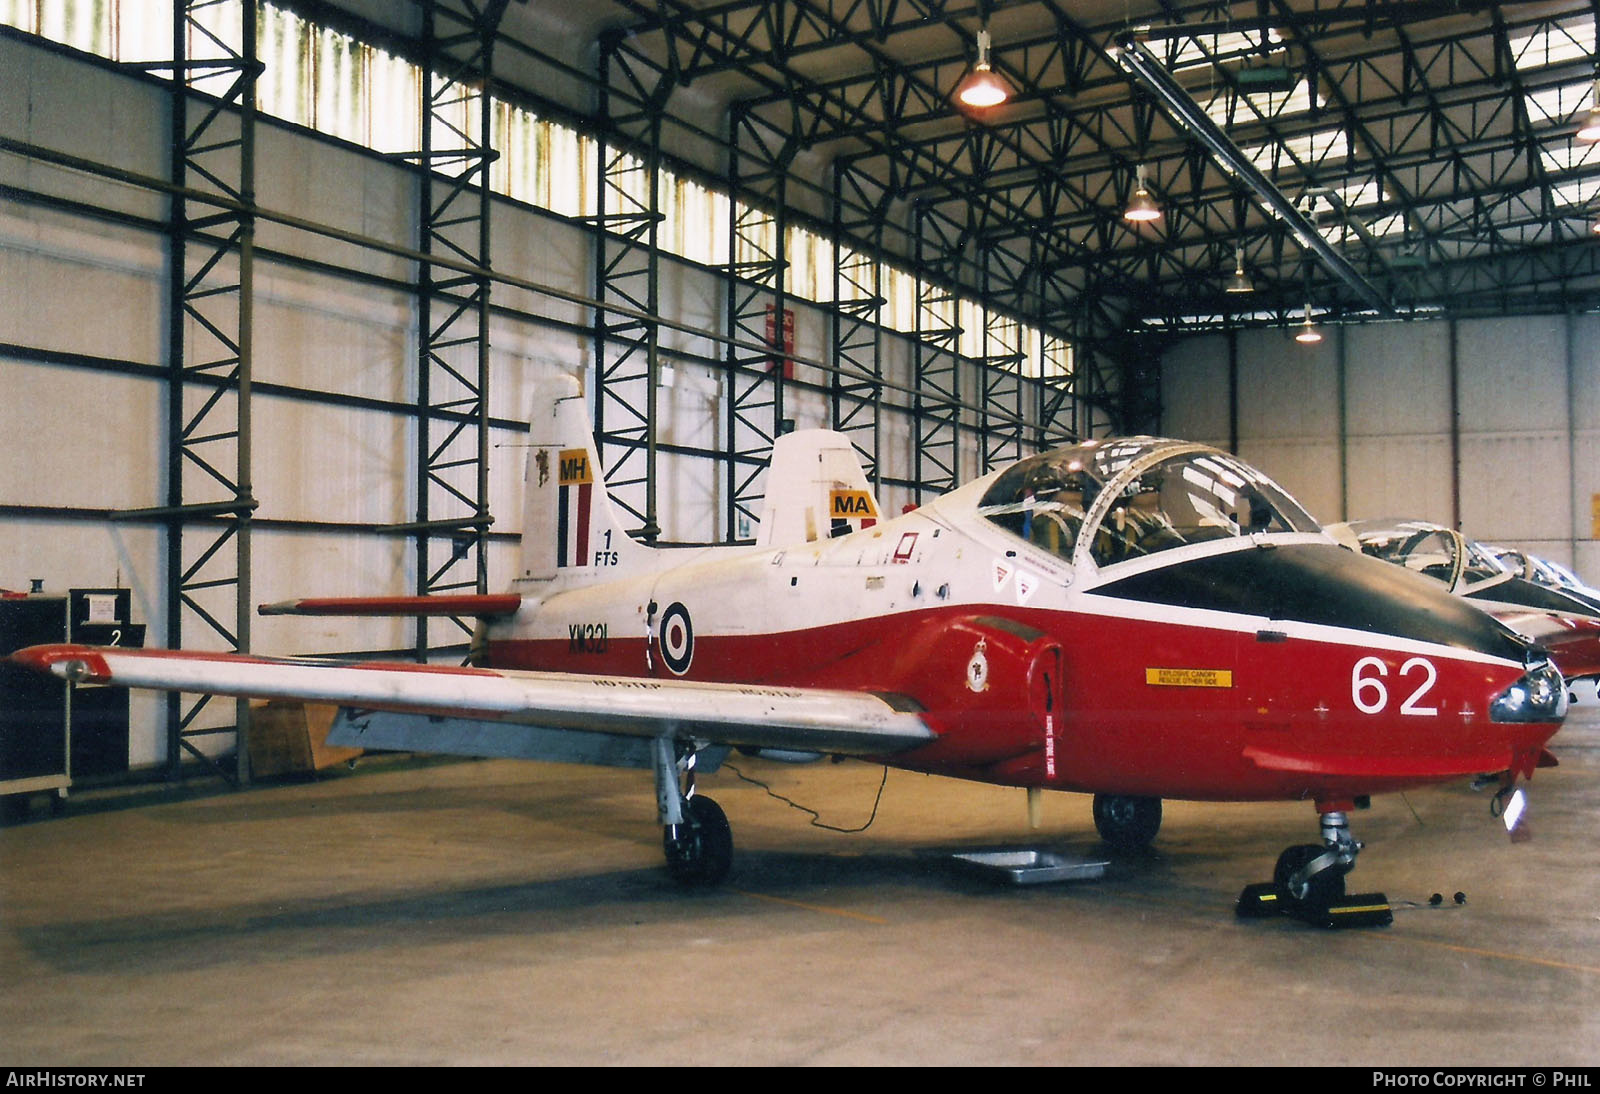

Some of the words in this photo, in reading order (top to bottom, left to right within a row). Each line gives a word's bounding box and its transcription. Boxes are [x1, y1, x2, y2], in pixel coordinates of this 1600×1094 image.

[560, 457, 586, 480] MH
[834, 495, 870, 513] MA
[604, 529, 611, 550] 1
[594, 551, 618, 566] FTS
[111, 629, 121, 647] 2
[568, 623, 608, 655] XW321
[1191, 670, 1217, 678] CANOPY
[1352, 656, 1438, 716] 62
